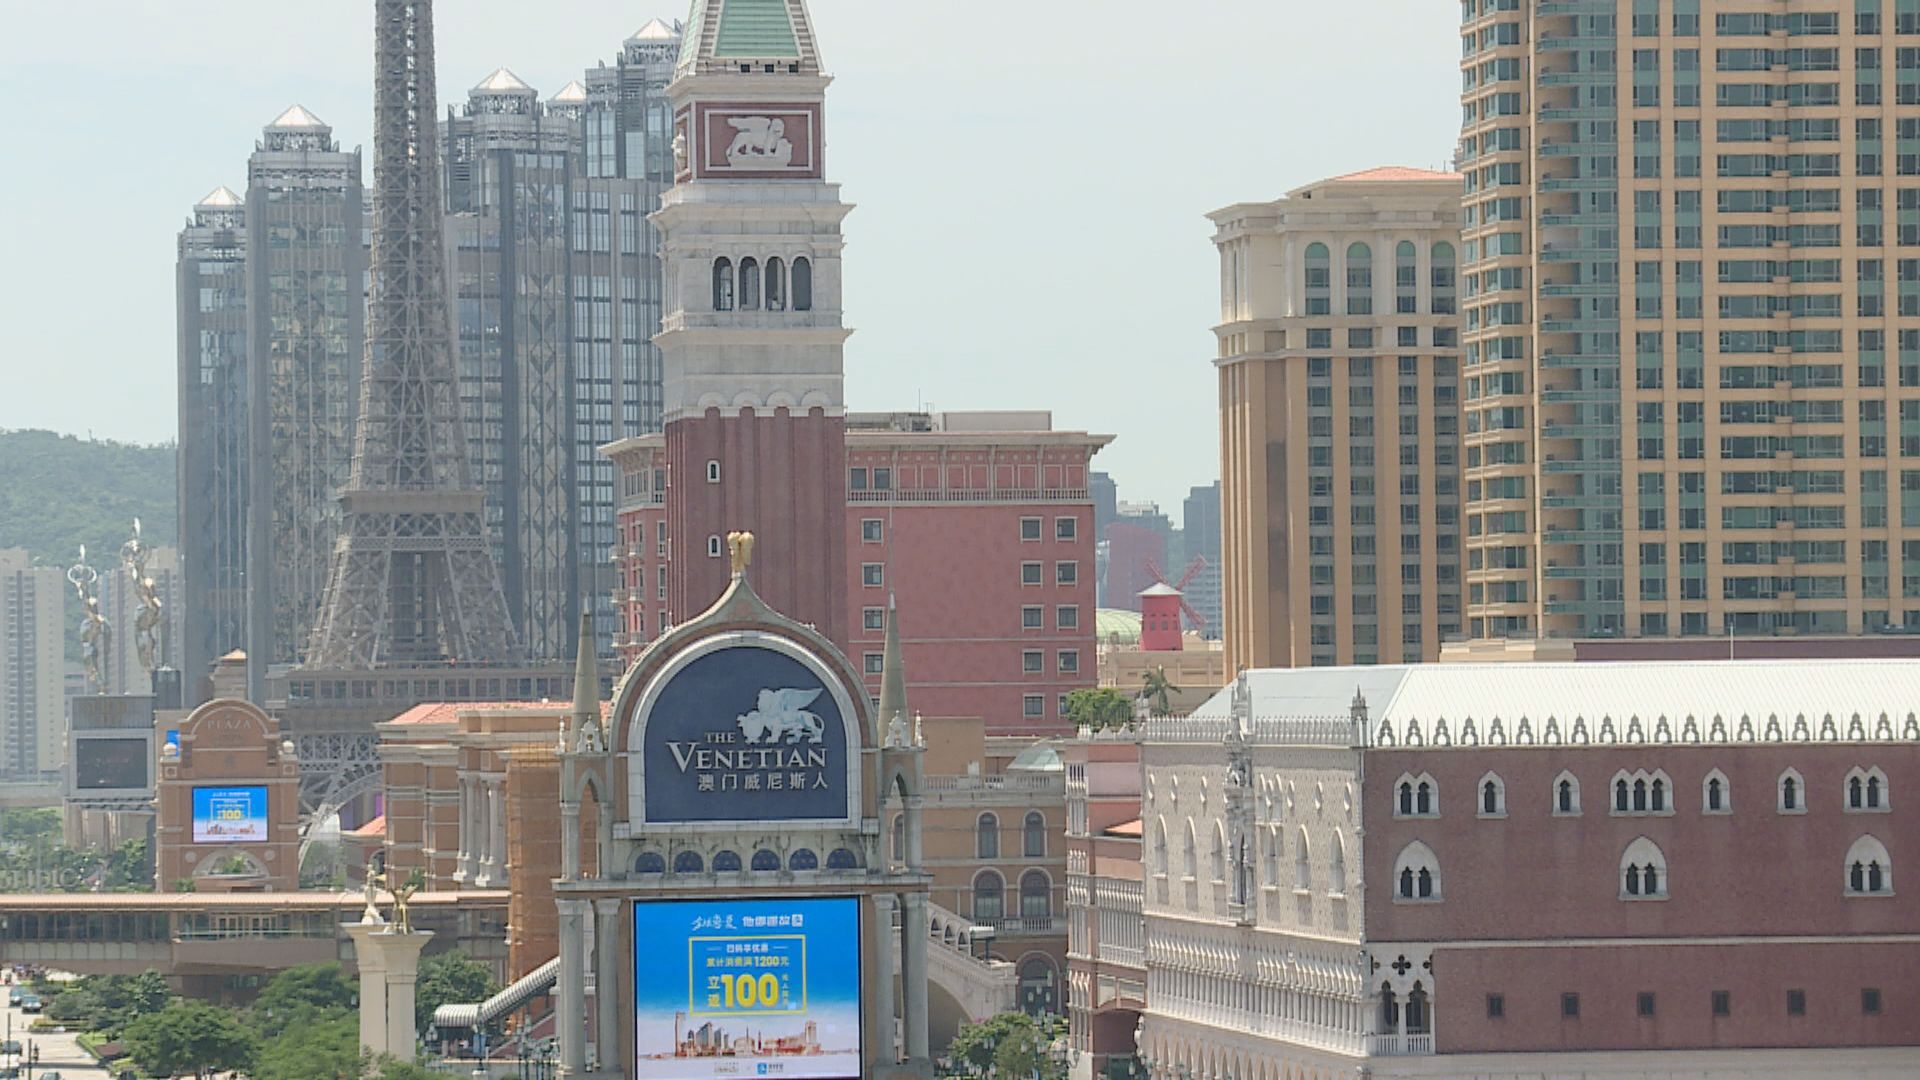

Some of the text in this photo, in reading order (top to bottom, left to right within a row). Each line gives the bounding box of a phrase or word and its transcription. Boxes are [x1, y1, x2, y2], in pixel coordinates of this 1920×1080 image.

[207, 719, 252, 729] PLAZA
[704, 732, 736, 744] THE
[666, 742, 828, 773] VENETIAN
[698, 772, 829, 791] 澳门威尼斯人
[721, 972, 779, 1008] 100
